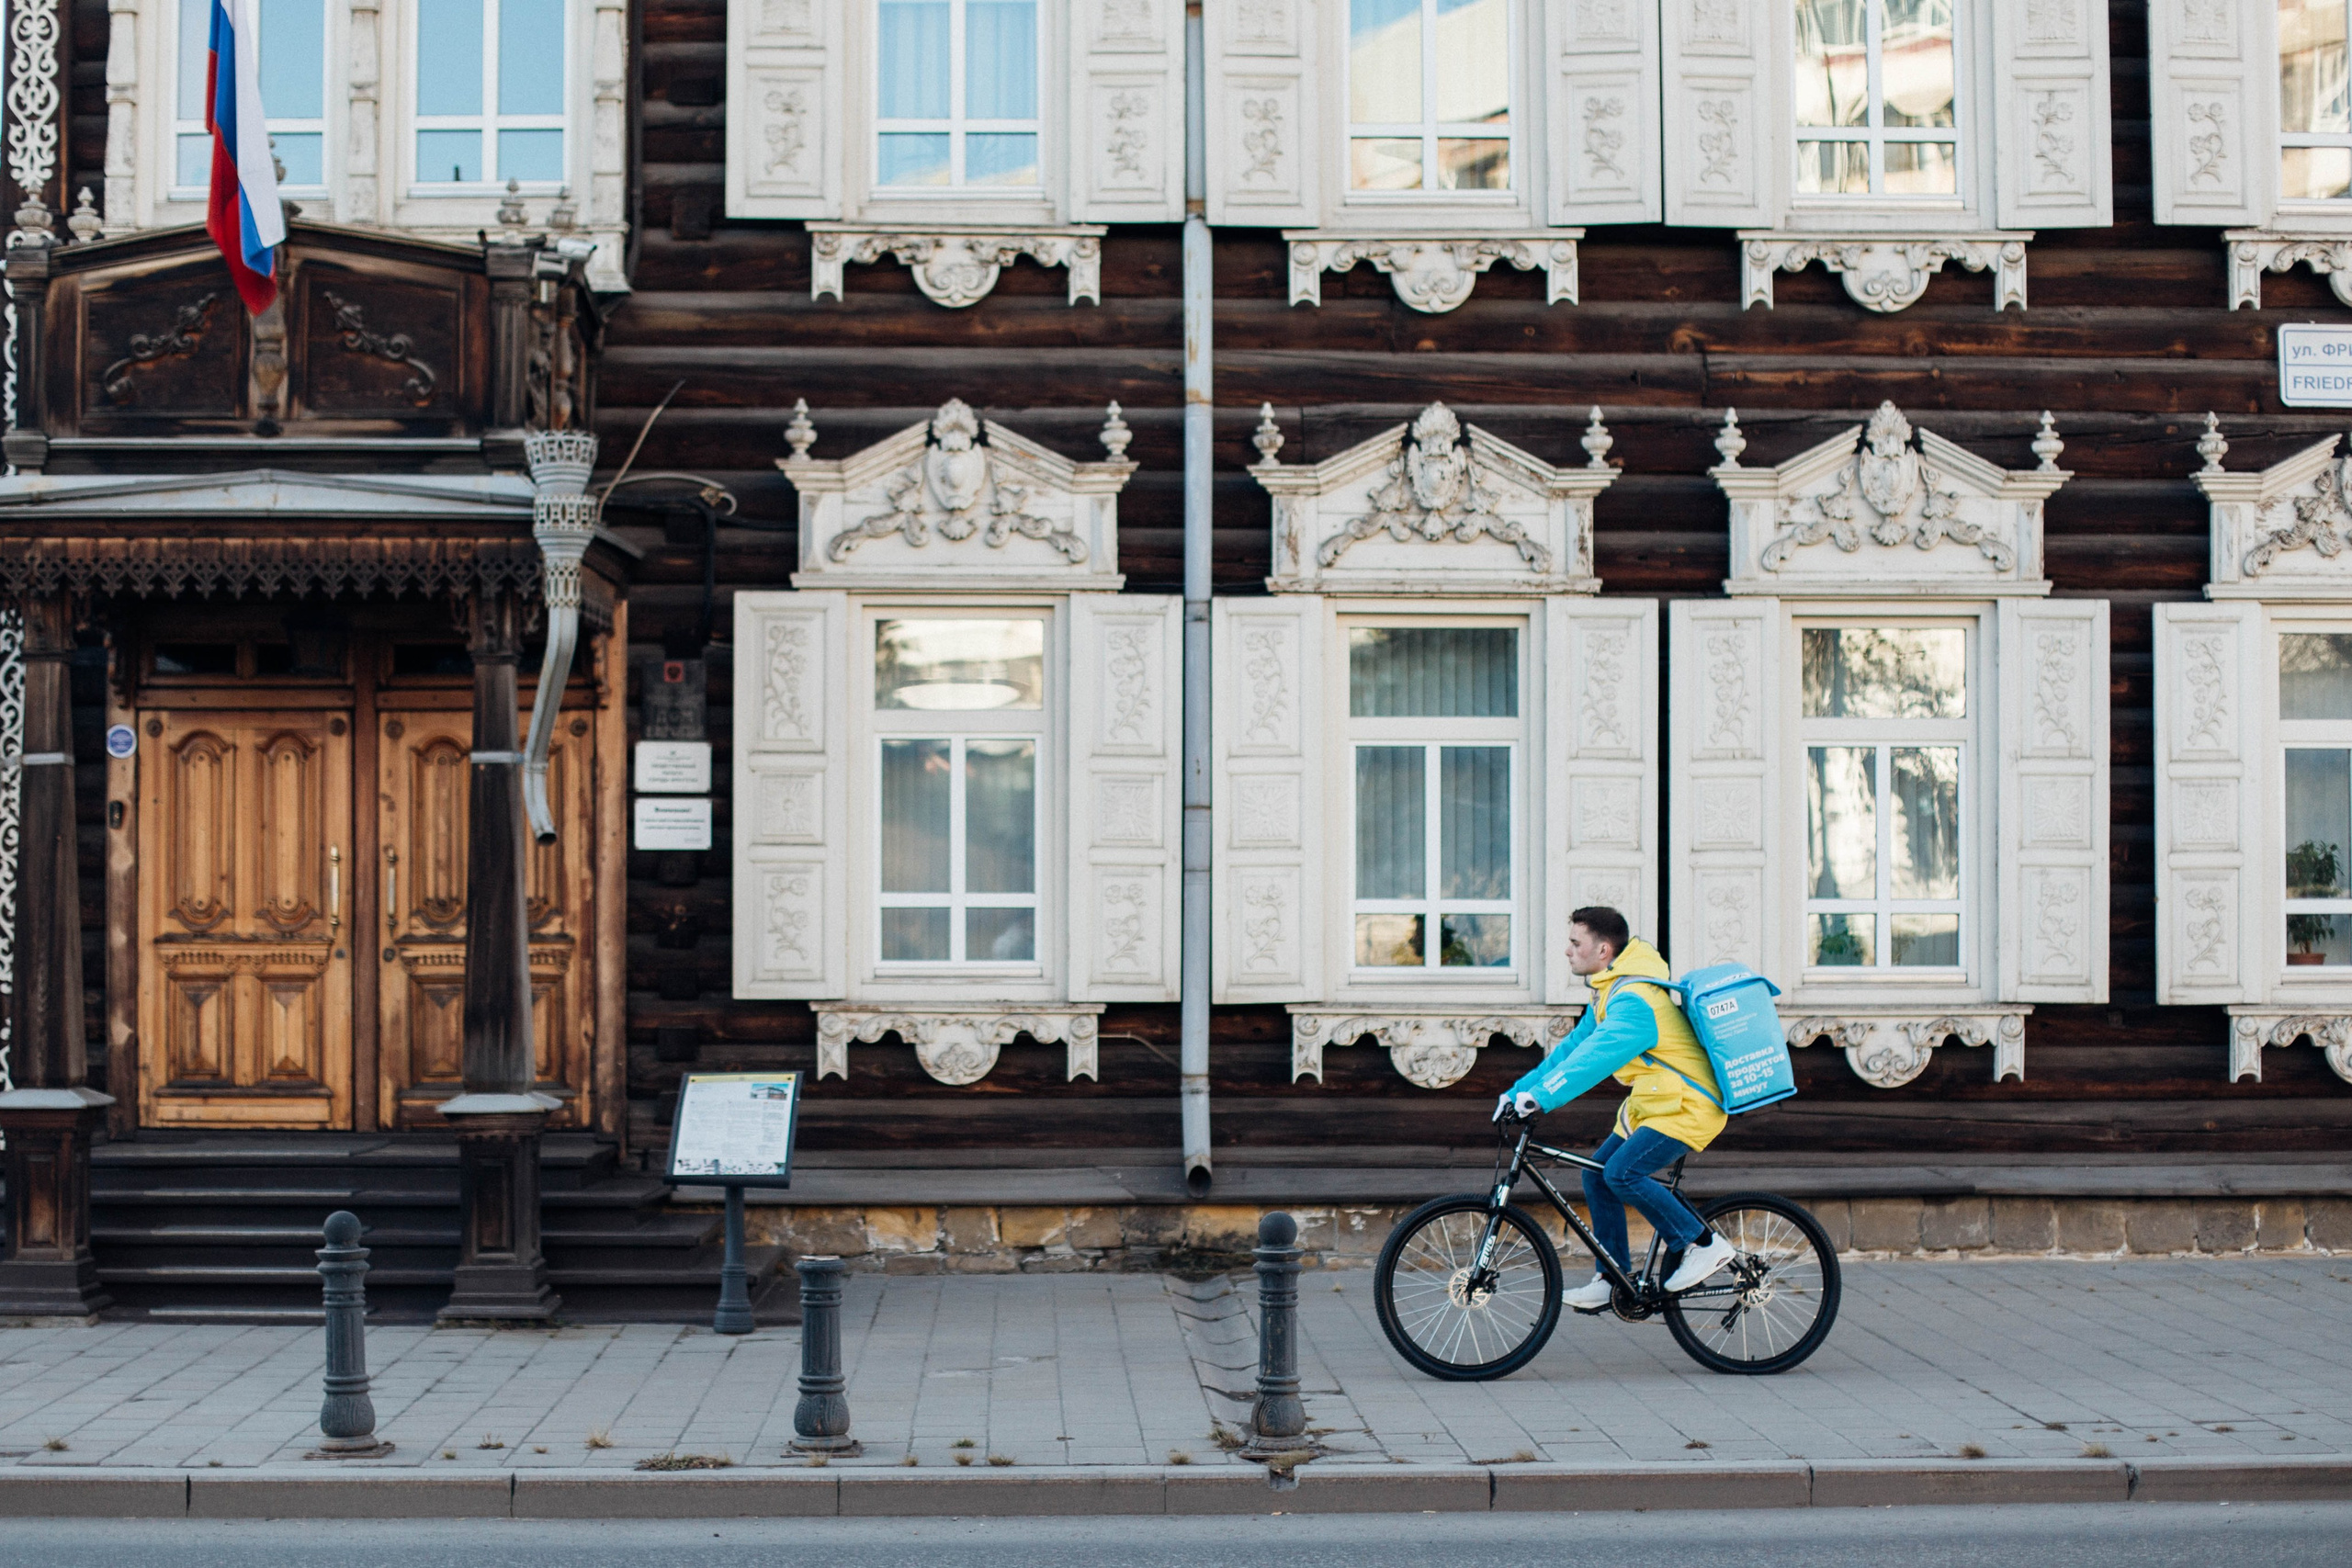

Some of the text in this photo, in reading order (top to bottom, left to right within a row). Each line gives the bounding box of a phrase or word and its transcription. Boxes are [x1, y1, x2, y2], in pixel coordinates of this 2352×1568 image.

[2292, 345, 2316, 358] ул.
[1710, 1001, 1736, 1016] 0747A
[1724, 1046, 1775, 1070] доставка
[1726, 1054, 1786, 1079] продуктов
[1730, 1079, 1744, 1089] за
[1733, 1081, 1769, 1100] минут
